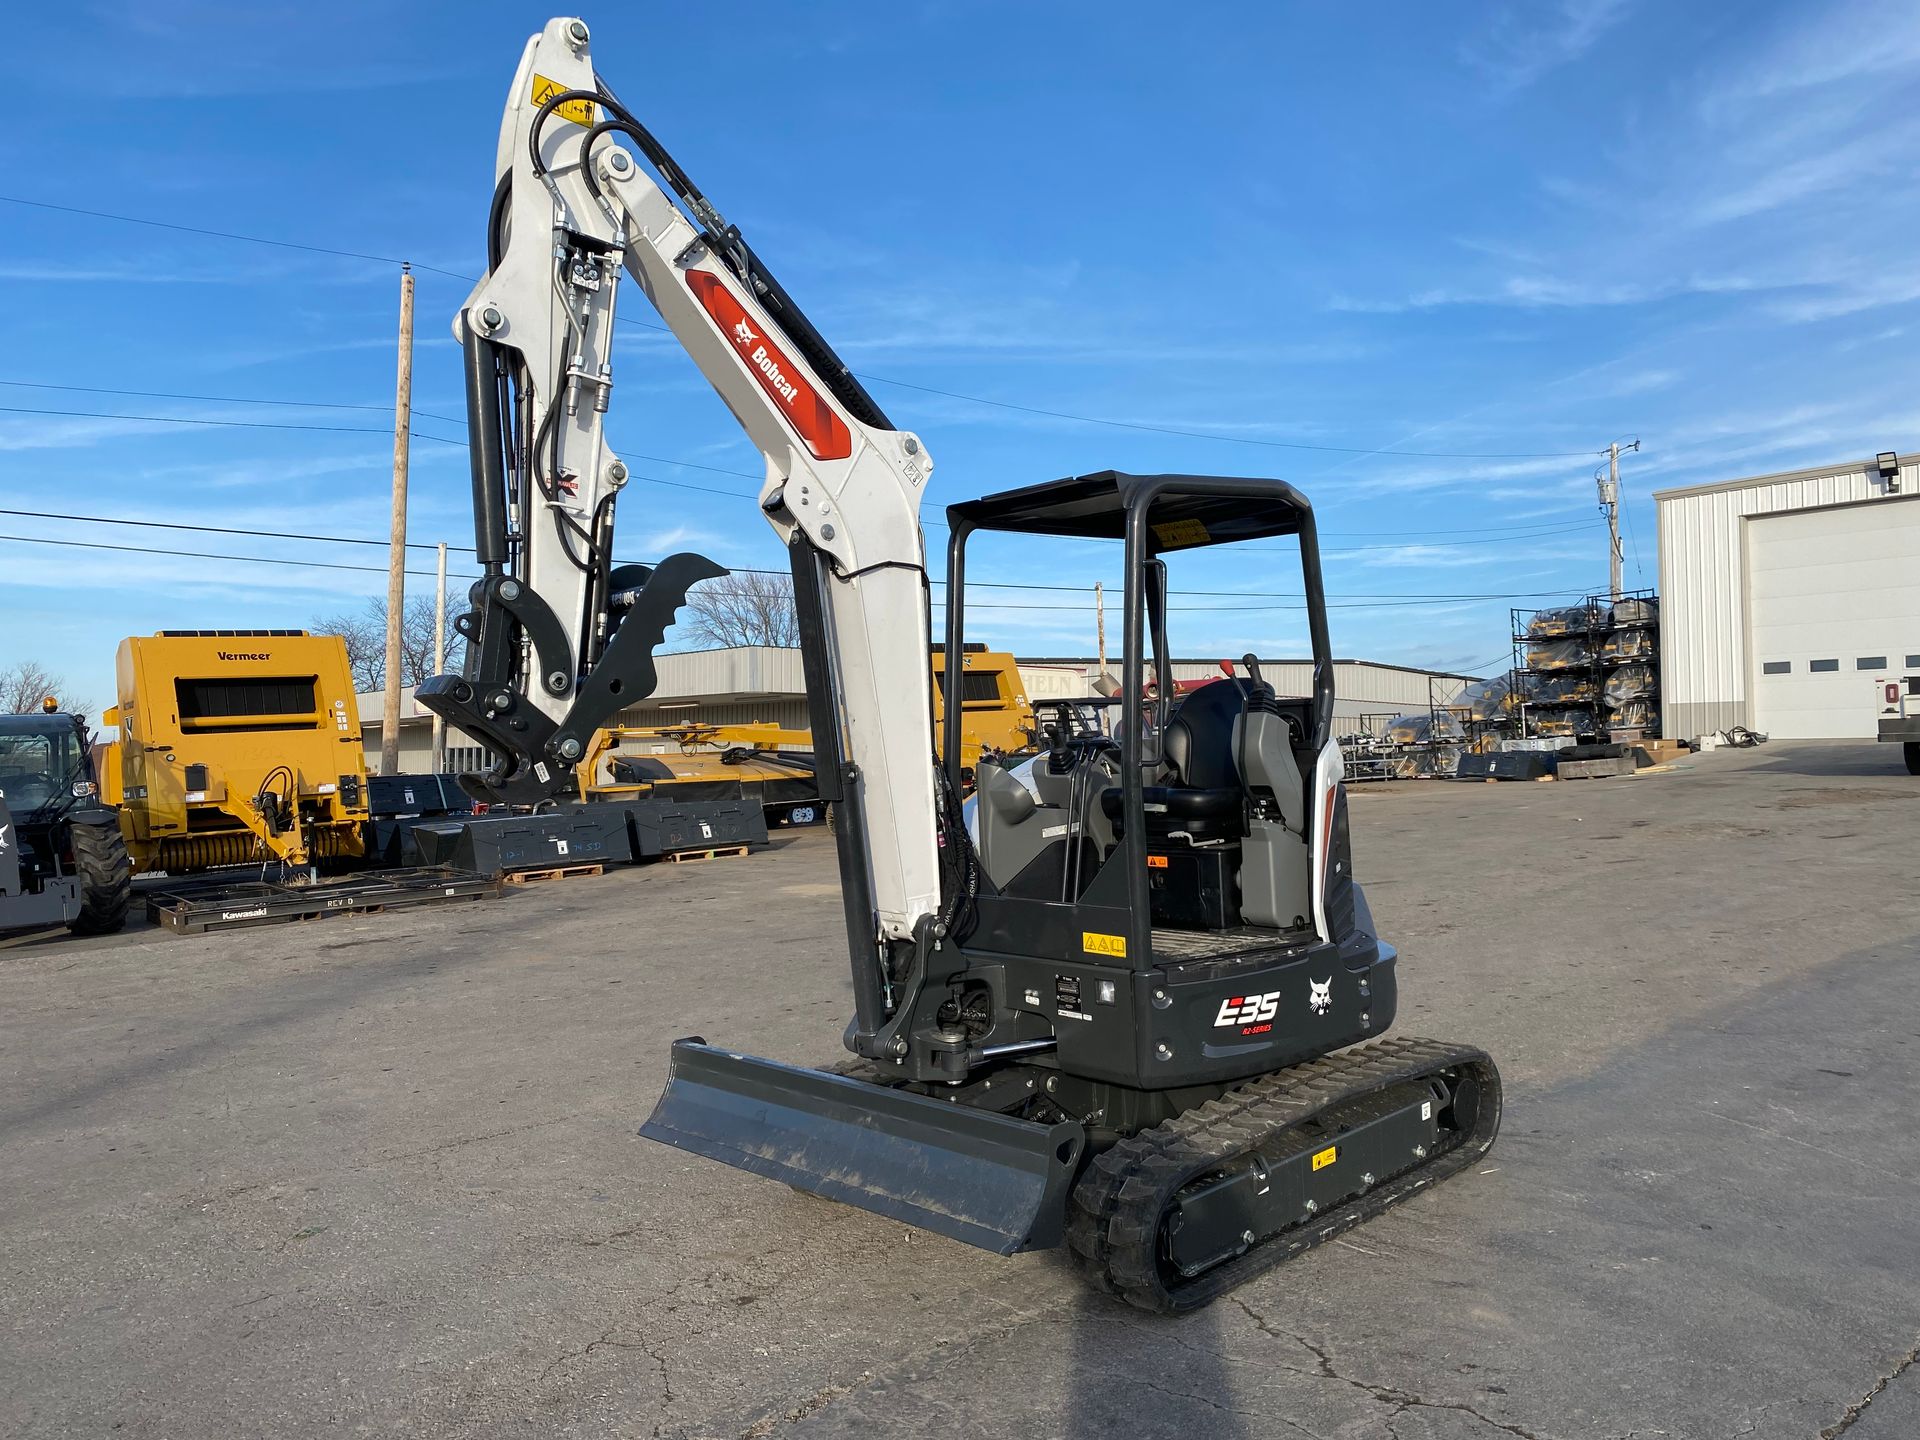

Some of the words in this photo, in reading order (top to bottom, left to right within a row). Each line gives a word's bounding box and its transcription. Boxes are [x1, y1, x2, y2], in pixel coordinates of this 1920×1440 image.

[751, 345, 798, 403] Bobcat
[217, 651, 271, 661] Vermeer
[327, 899, 343, 907] REV
[222, 908, 267, 920] Kawasaki
[1213, 991, 1281, 1027] E35
[1241, 1023, 1272, 1035] R2-SERIES
